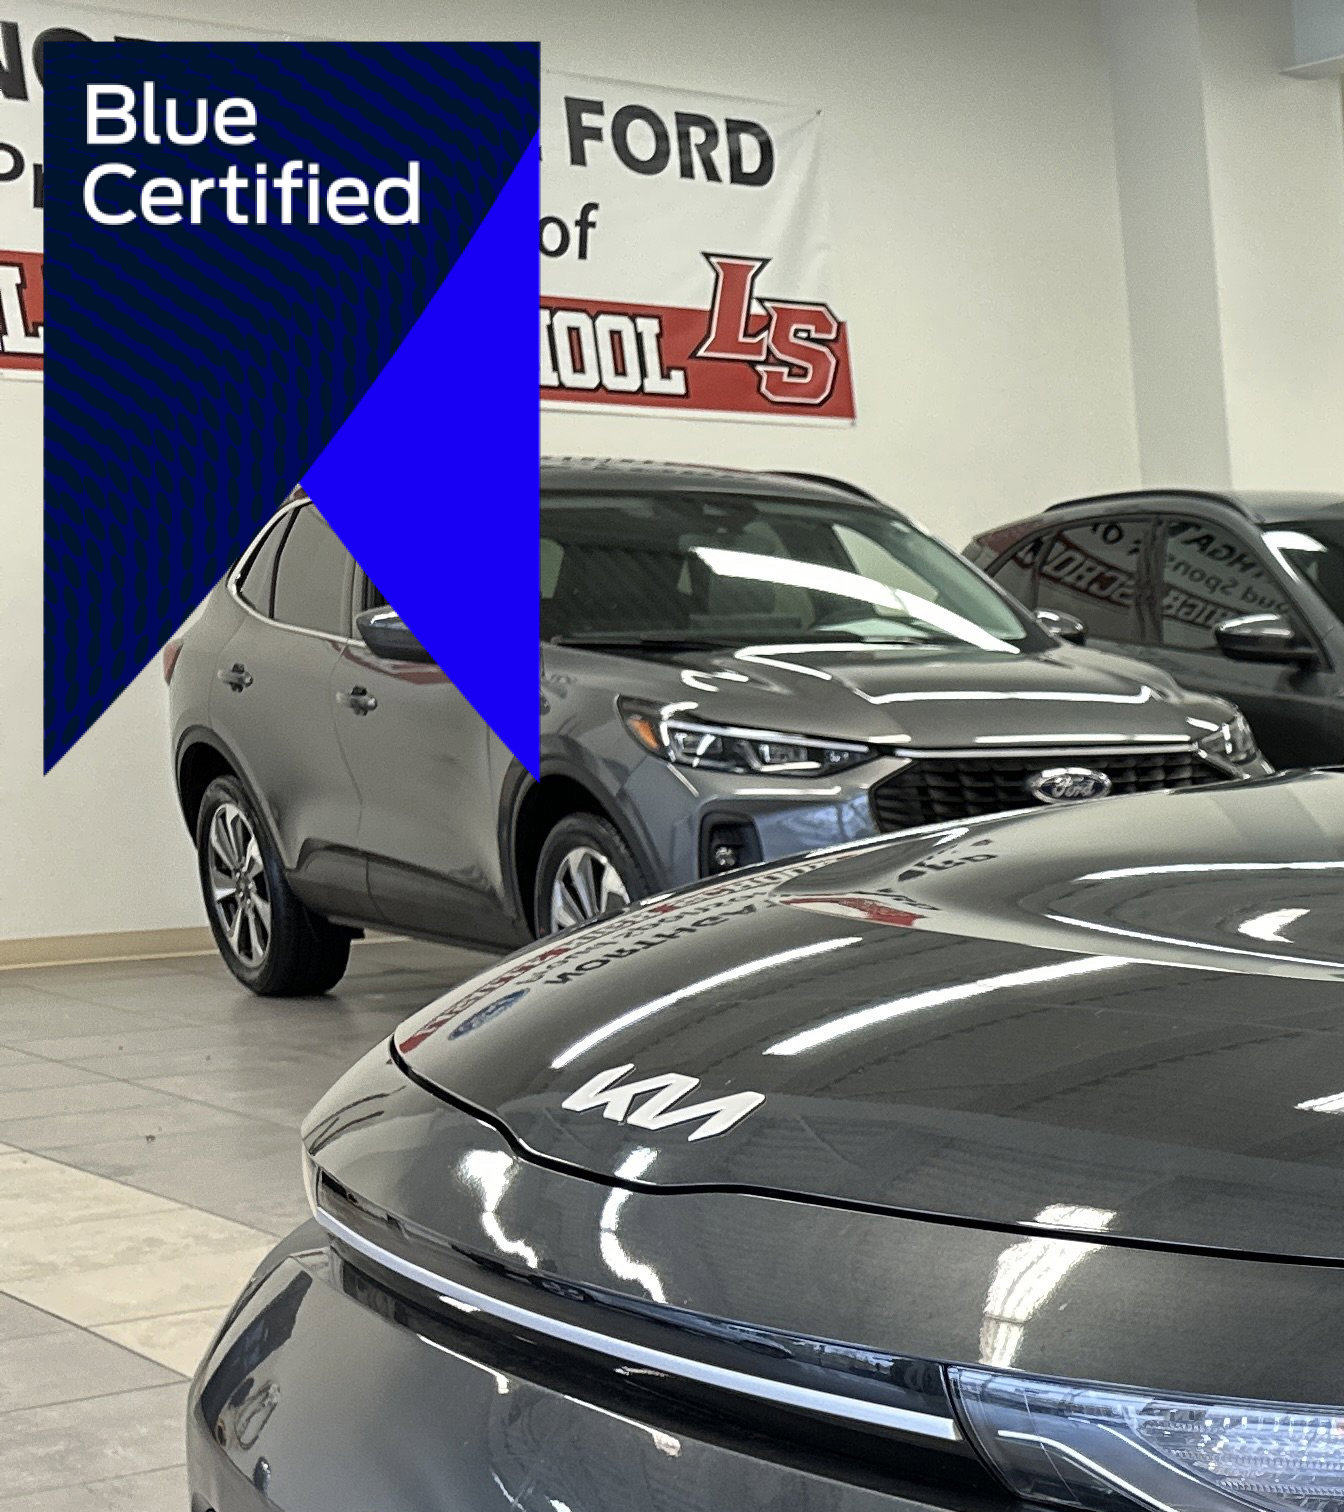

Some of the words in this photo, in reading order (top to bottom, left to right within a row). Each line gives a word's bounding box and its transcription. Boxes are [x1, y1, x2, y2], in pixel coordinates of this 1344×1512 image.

[563, 95, 775, 188] FORD
[539, 202, 600, 261] of
[688, 251, 841, 407] LS
[1051, 773, 1097, 798] Ford
